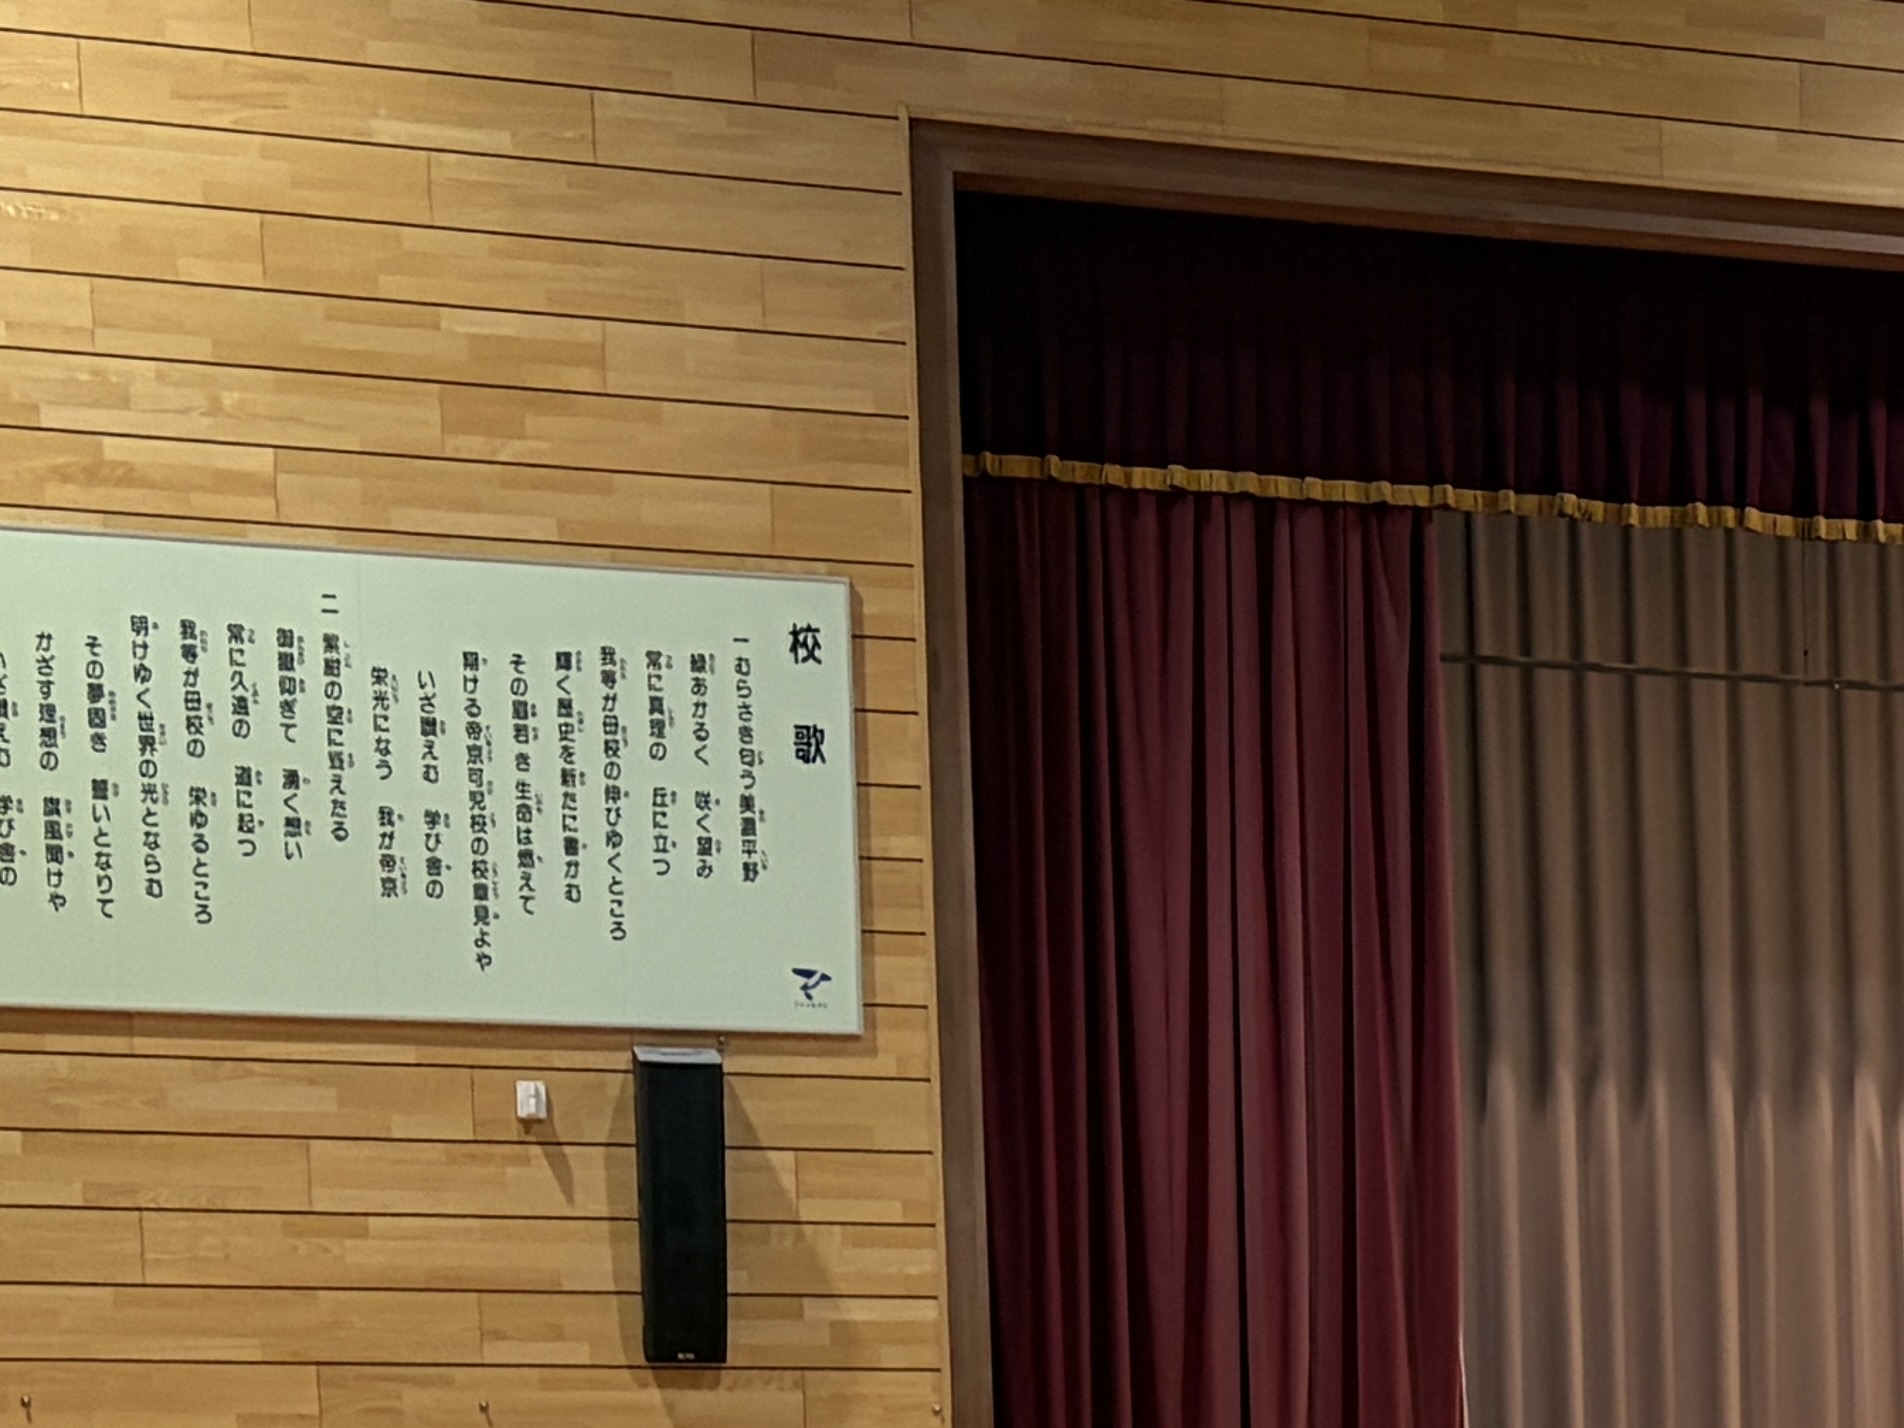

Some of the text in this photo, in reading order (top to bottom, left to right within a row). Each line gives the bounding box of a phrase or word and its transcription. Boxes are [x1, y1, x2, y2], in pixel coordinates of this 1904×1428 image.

[91, 778, 115, 919] いとなりて
[652, 787, 671, 877] 丘に立つ
